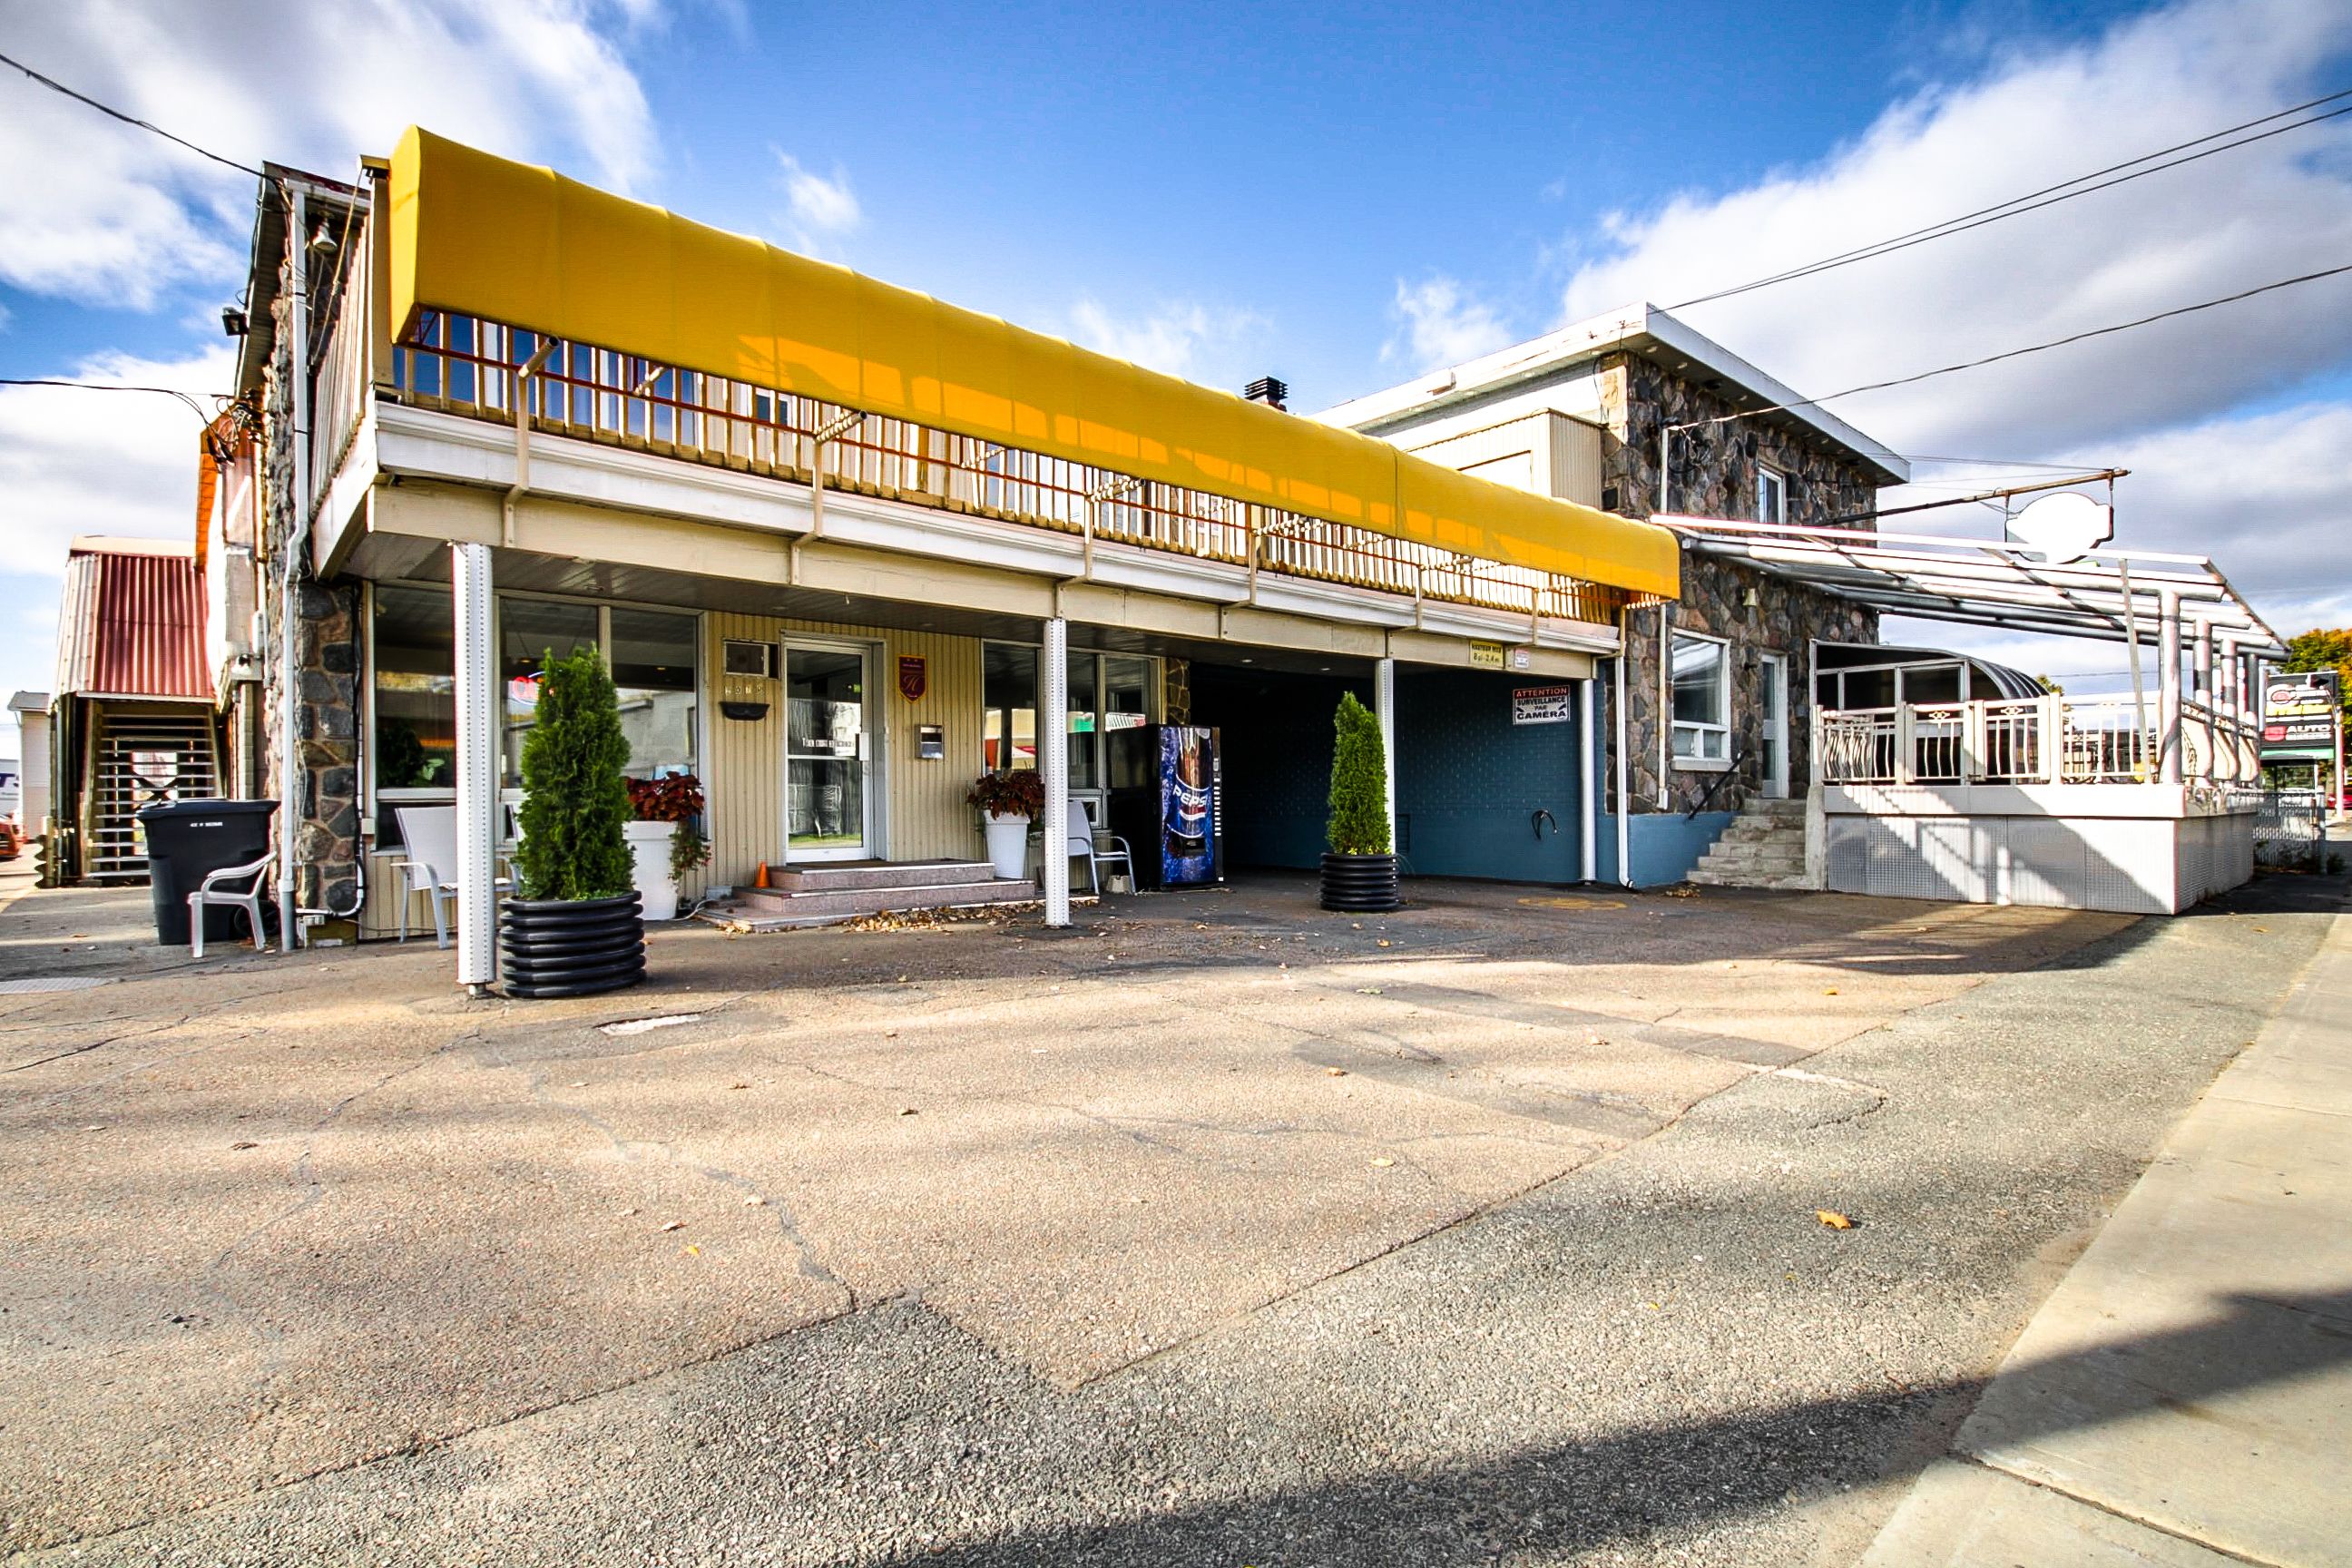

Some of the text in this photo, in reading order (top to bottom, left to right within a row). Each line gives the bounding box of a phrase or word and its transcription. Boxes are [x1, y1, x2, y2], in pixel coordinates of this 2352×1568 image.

[1516, 687, 1567, 698] ATTENTION
[1517, 696, 1565, 706] SURVEILLANCE
[2287, 724, 2331, 733] AUTO
